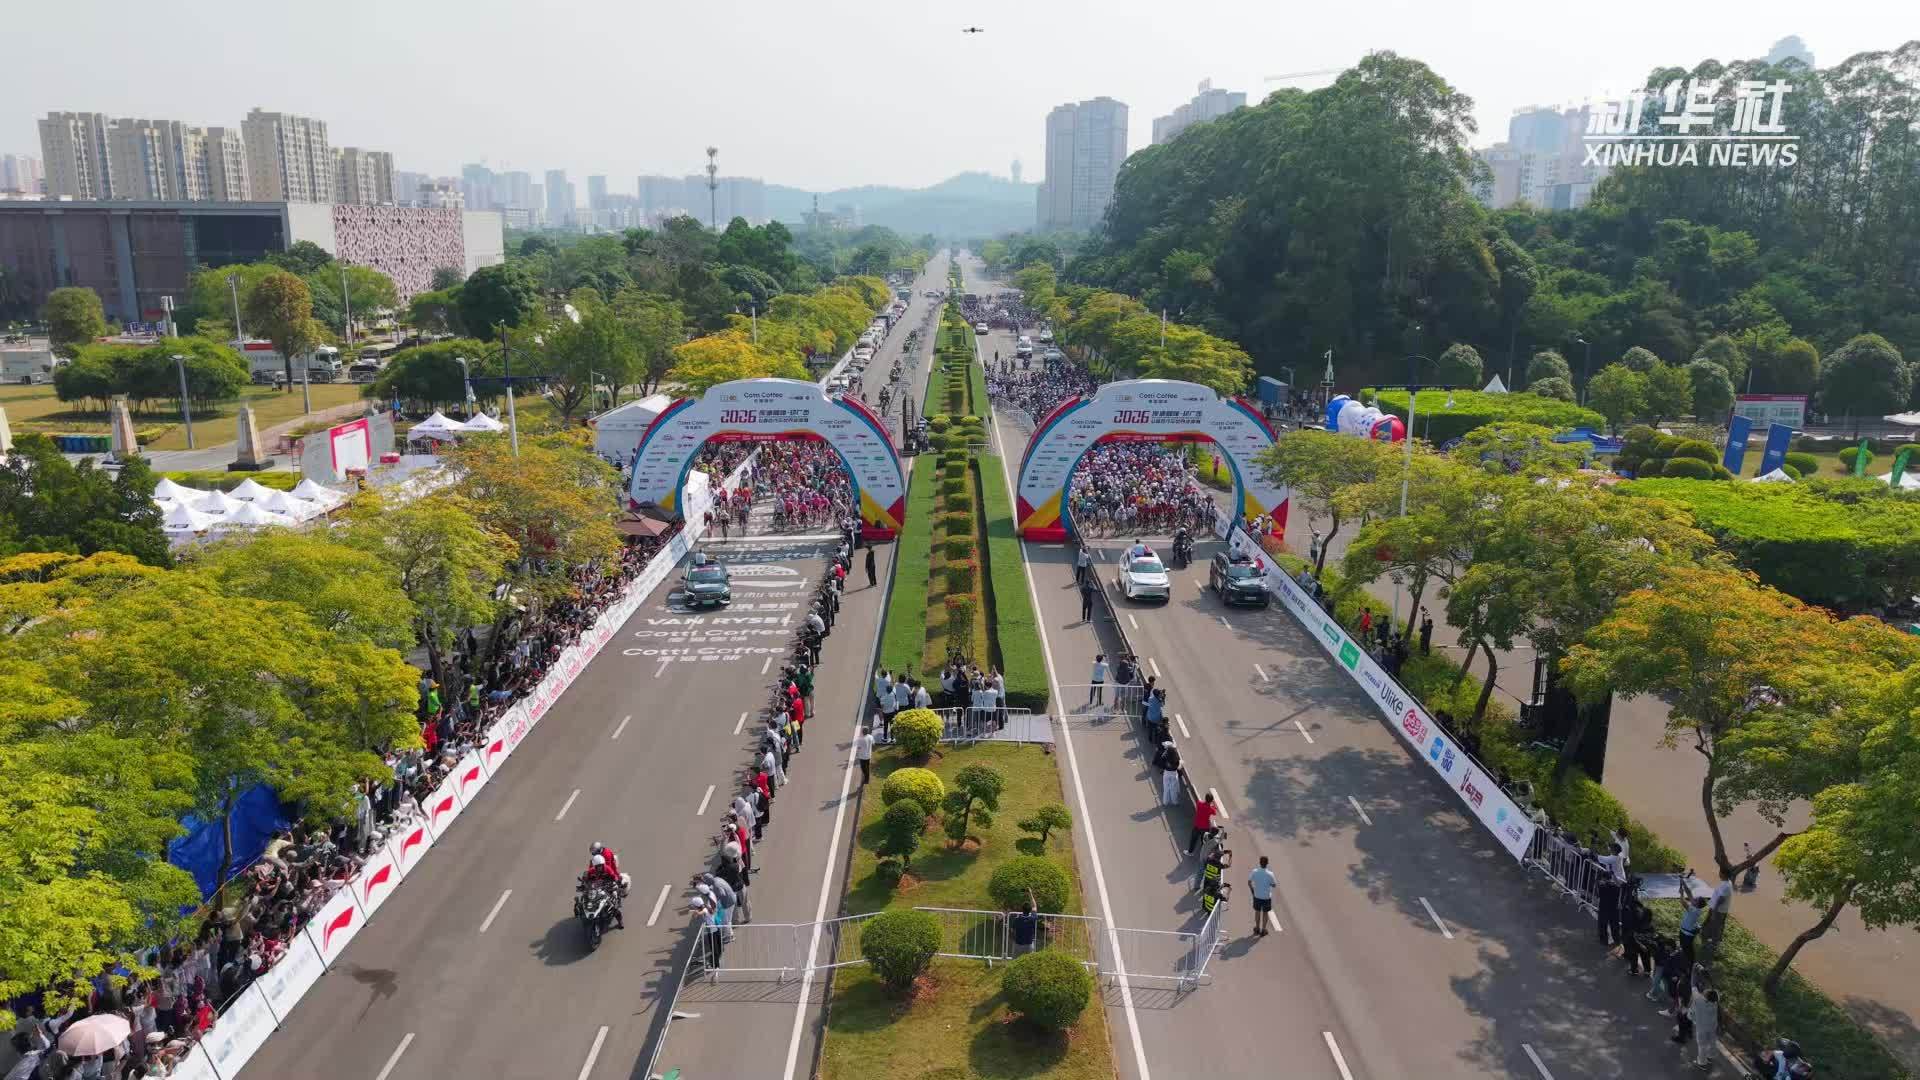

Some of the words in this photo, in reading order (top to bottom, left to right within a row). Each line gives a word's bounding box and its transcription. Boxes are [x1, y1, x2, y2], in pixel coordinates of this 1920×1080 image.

[721, 409, 757, 423] 2026
[1113, 410, 1150, 424] 2026
[646, 617, 705, 626] VAN
[634, 629, 696, 638] Cotti
[622, 647, 689, 656] Cotti
[697, 646, 785, 655] Coffee
[1380, 682, 1404, 716] Ulike
[1440, 757, 1454, 773] 100
